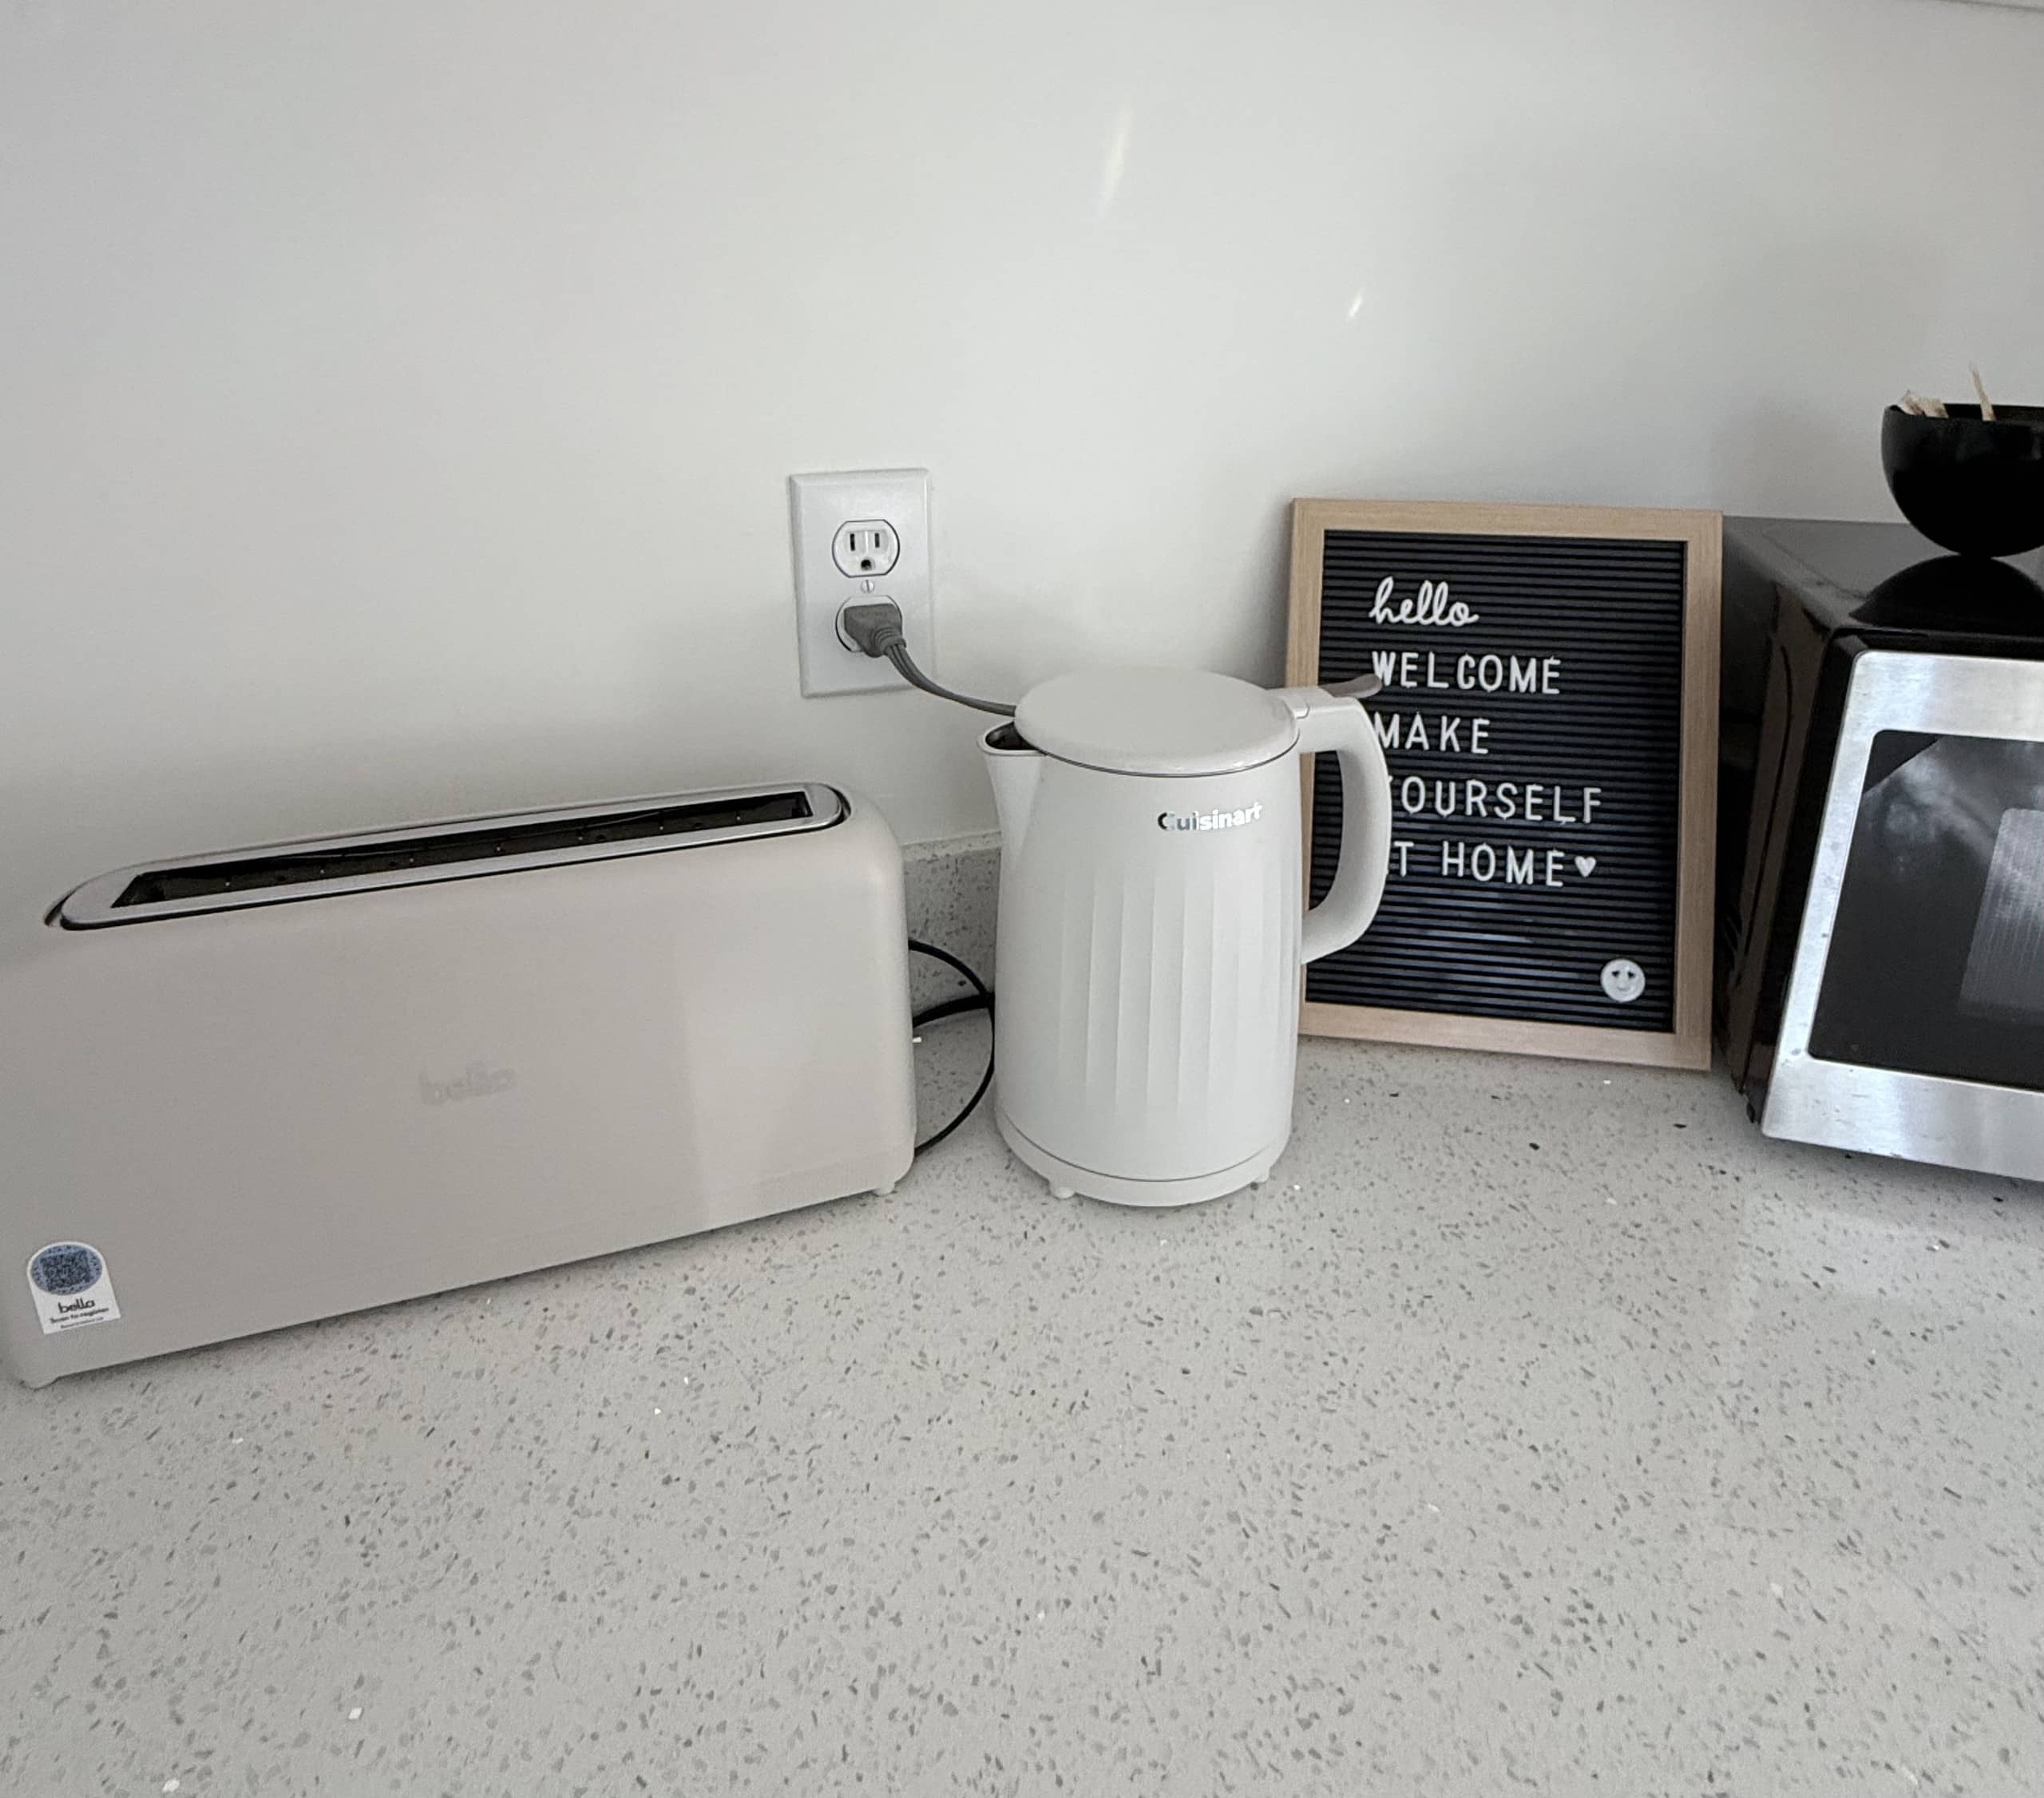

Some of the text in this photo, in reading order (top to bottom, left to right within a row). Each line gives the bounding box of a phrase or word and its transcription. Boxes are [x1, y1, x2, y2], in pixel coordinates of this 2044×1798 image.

[1369, 576, 1480, 627] hello
[1371, 651, 1562, 695] WELCOME
[1373, 711, 1491, 754] MAKE
[1158, 802, 1262, 831] Cuisinart
[1387, 775, 1602, 825] OURSELF
[1386, 841, 1565, 887] T HOME
[57, 1297, 96, 1313] bella
